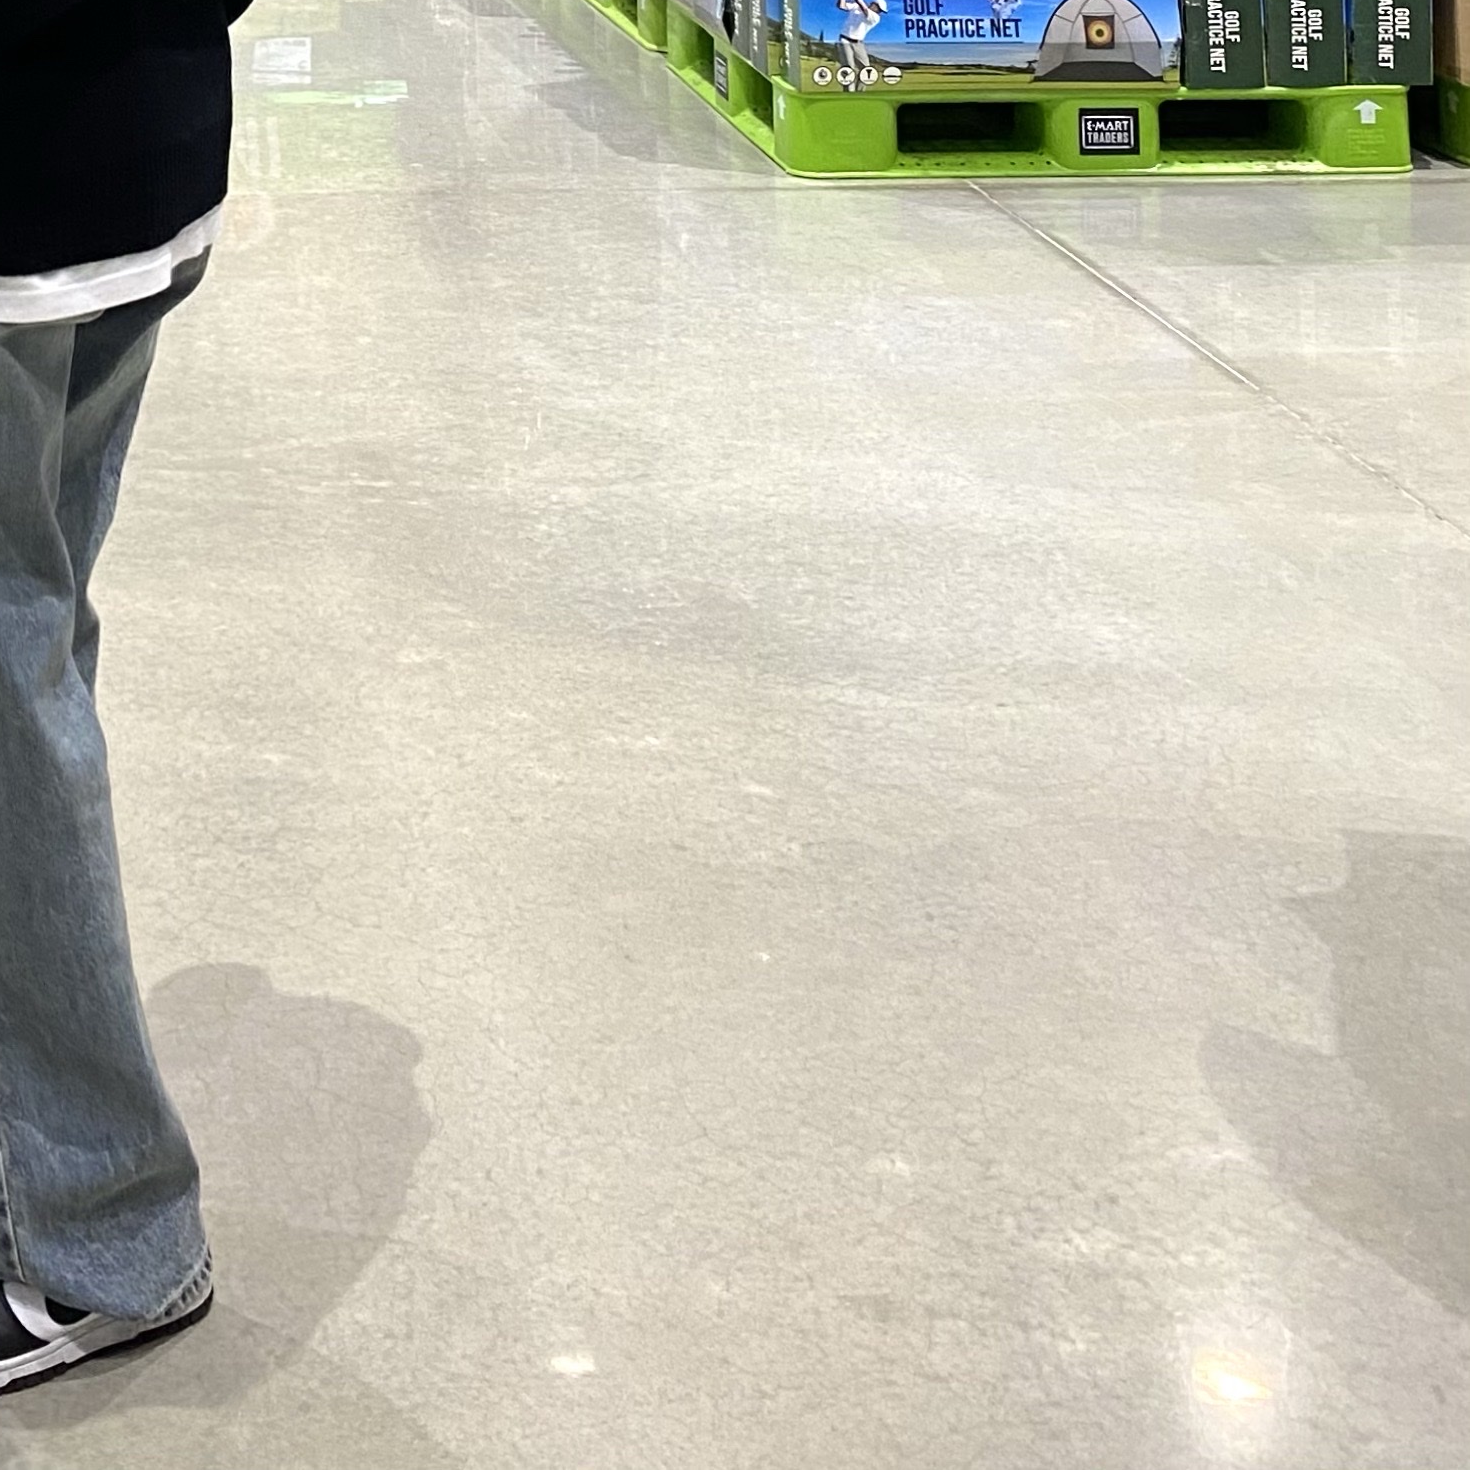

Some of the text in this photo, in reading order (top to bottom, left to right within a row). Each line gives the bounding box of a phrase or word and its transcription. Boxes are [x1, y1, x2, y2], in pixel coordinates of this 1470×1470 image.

[905, 18, 1022, 38] PRACTICE NET
[1224, 11, 1240, 42] GOLF
[1394, 8, 1410, 40] GOLF
[1210, 48, 1226, 73] NET
[1378, 44, 1394, 69] NET
[1087, 131, 1129, 144] TRADERS
